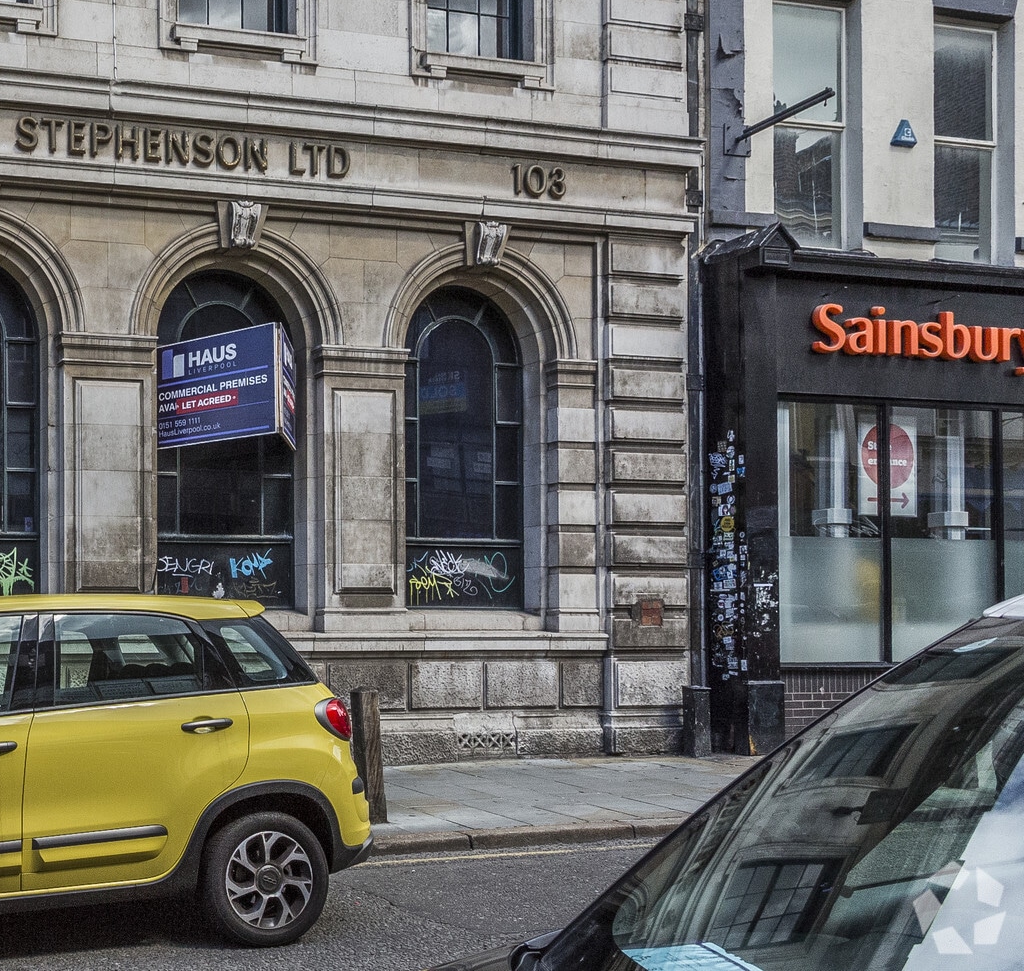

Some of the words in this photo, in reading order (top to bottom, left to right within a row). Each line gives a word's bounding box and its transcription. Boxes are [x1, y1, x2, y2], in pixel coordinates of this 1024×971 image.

[16, 116, 268, 173] STEPHENSON
[289, 141, 351, 179] LTD
[511, 163, 567, 200] 103
[812, 303, 1024, 377] Sainsbur
[188, 343, 237, 368] HAUS
[188, 361, 237, 376] LIVERPOOL
[158, 383, 218, 402] COMMERCIAL
[220, 374, 268, 391] PREMISES
[181, 400, 197, 410] LET
[197, 394, 232, 407] AGREED
[158, 420, 173, 430] 0151
[174, 418, 187, 427] 559
[188, 416, 201, 425] 1111
